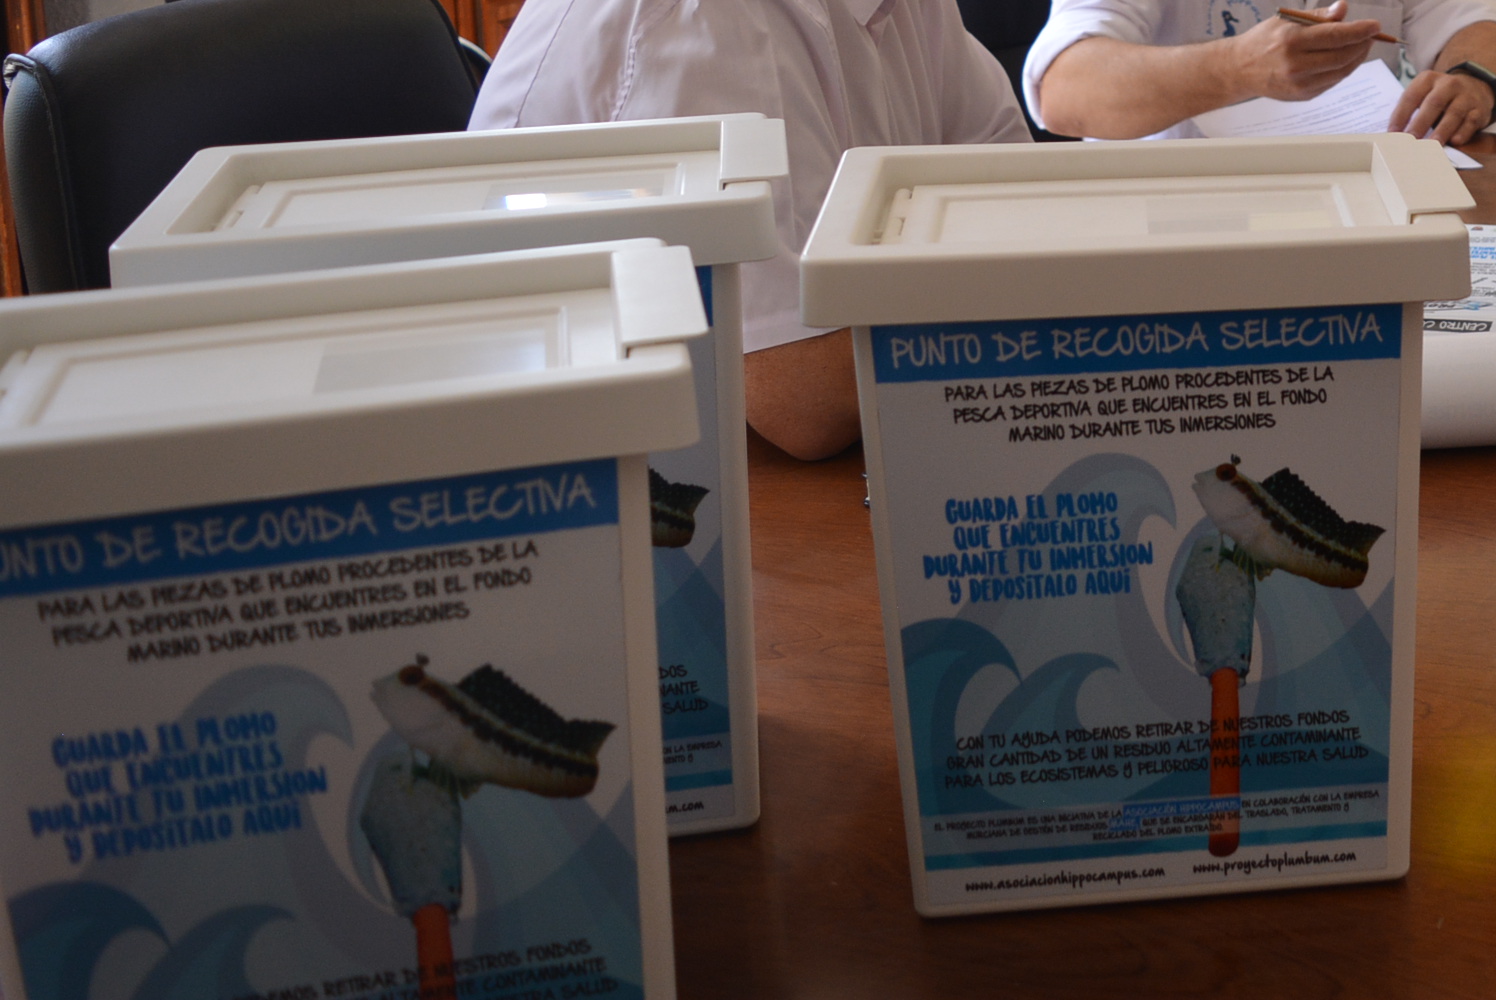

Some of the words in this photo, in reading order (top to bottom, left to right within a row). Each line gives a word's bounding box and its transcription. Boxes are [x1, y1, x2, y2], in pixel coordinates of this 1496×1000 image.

[891, 336, 982, 369] PUNTO
[991, 333, 1042, 362] DE
[1051, 324, 1209, 359] RECOGIDA
[1220, 314, 1383, 350] SELECTIVA
[1440, 321, 1487, 331] CENTRO
[945, 384, 988, 402] PARA
[993, 383, 1026, 399] LAS
[1031, 379, 1090, 398] PIEZAS
[1092, 377, 1117, 394] DE
[1121, 374, 1170, 393] PLOMO
[1175, 369, 1283, 390] PROCEDENTES
[1285, 367, 1310, 383] DE
[1313, 366, 1334, 382] LA
[953, 406, 1007, 424] PESCA
[1009, 401, 1092, 420] DEPORTIVA
[1098, 399, 1128, 415] QUE
[1132, 394, 1228, 414] ENCUENTRES
[1233, 392, 1251, 408] EN
[1257, 391, 1276, 407] EL
[1280, 388, 1327, 405] FONDO
[1009, 424, 1065, 442] MARINO
[1069, 420, 1142, 440] DURANTE
[1144, 418, 1175, 435] TUS
[1179, 413, 1276, 433] INMERSIONES
[96, 527, 161, 568] DE
[173, 501, 378, 559] RECOGIDA
[389, 474, 597, 532] SELECTIVA
[945, 497, 1019, 525] GUARDA
[1025, 495, 1048, 519] EL
[1056, 492, 1117, 517] PLOMO
[953, 524, 992, 551] QUE
[999, 517, 1120, 548] ENCUENTRES
[38, 596, 96, 622] PARA
[101, 591, 144, 613] LAS
[152, 581, 227, 608] PIEZAS
[231, 575, 260, 596] DE
[268, 567, 330, 592] PLOMO
[337, 549, 474, 583] PROCEDENTES
[476, 543, 507, 565] DE
[511, 539, 539, 560] LA
[922, 550, 1009, 580] DURANTE
[1017, 549, 1042, 574] TU
[1049, 541, 1153, 572] INMERSION
[53, 620, 123, 647] PESCA
[126, 606, 234, 636] DEPORTIVA
[242, 601, 274, 620] QUE
[285, 584, 407, 616] ENCUENTRES
[414, 578, 437, 599] EN
[444, 575, 468, 596] EL
[473, 566, 531, 591] FONDO
[128, 637, 200, 662] MARINO
[205, 621, 305, 653] DURANTE
[304, 619, 342, 640] TUS
[347, 602, 470, 634] INMERSIONES
[659, 664, 688, 680] DOS
[662, 698, 709, 714] SALUD
[53, 730, 150, 767] GUARDA
[157, 725, 187, 755] EL
[197, 714, 277, 748] PLOMO
[948, 754, 984, 768] GRAN
[989, 749, 1062, 768] CANTIDAD
[1065, 747, 1087, 762] DE
[1091, 745, 1108, 760] UN
[1113, 741, 1171, 758] RESIDUO
[1176, 736, 1256, 753] ALTAMENTE
[1261, 727, 1362, 747] CONTAMINANTE
[957, 735, 984, 751] CON
[988, 734, 1006, 748] TU
[1011, 730, 1061, 747] AYUDA
[1065, 726, 1131, 743] PODEMOS
[1135, 721, 1194, 739] RETIRAR
[1197, 719, 1218, 734] DE
[1224, 714, 1293, 730] NUESTROS
[1297, 710, 1350, 726] FONDOS
[66, 765, 116, 797] QUE
[125, 745, 283, 791] ENCUENTRES
[945, 773, 983, 789] PARA
[988, 772, 1016, 787] LOS
[1020, 764, 1119, 784] ECOSISTEMAS
[1137, 757, 1208, 776] PELIGROSO
[1214, 754, 1251, 770] PARA
[1257, 749, 1318, 766] NUESTRA
[1322, 745, 1369, 761] SALUD
[28, 792, 142, 838] DURANTE
[152, 789, 183, 821] TU
[194, 766, 327, 810] INMERSION
[965, 868, 1165, 892] www.asociacionhippocampus.com
[1193, 851, 1356, 876] www.proyectoplumbum.com
